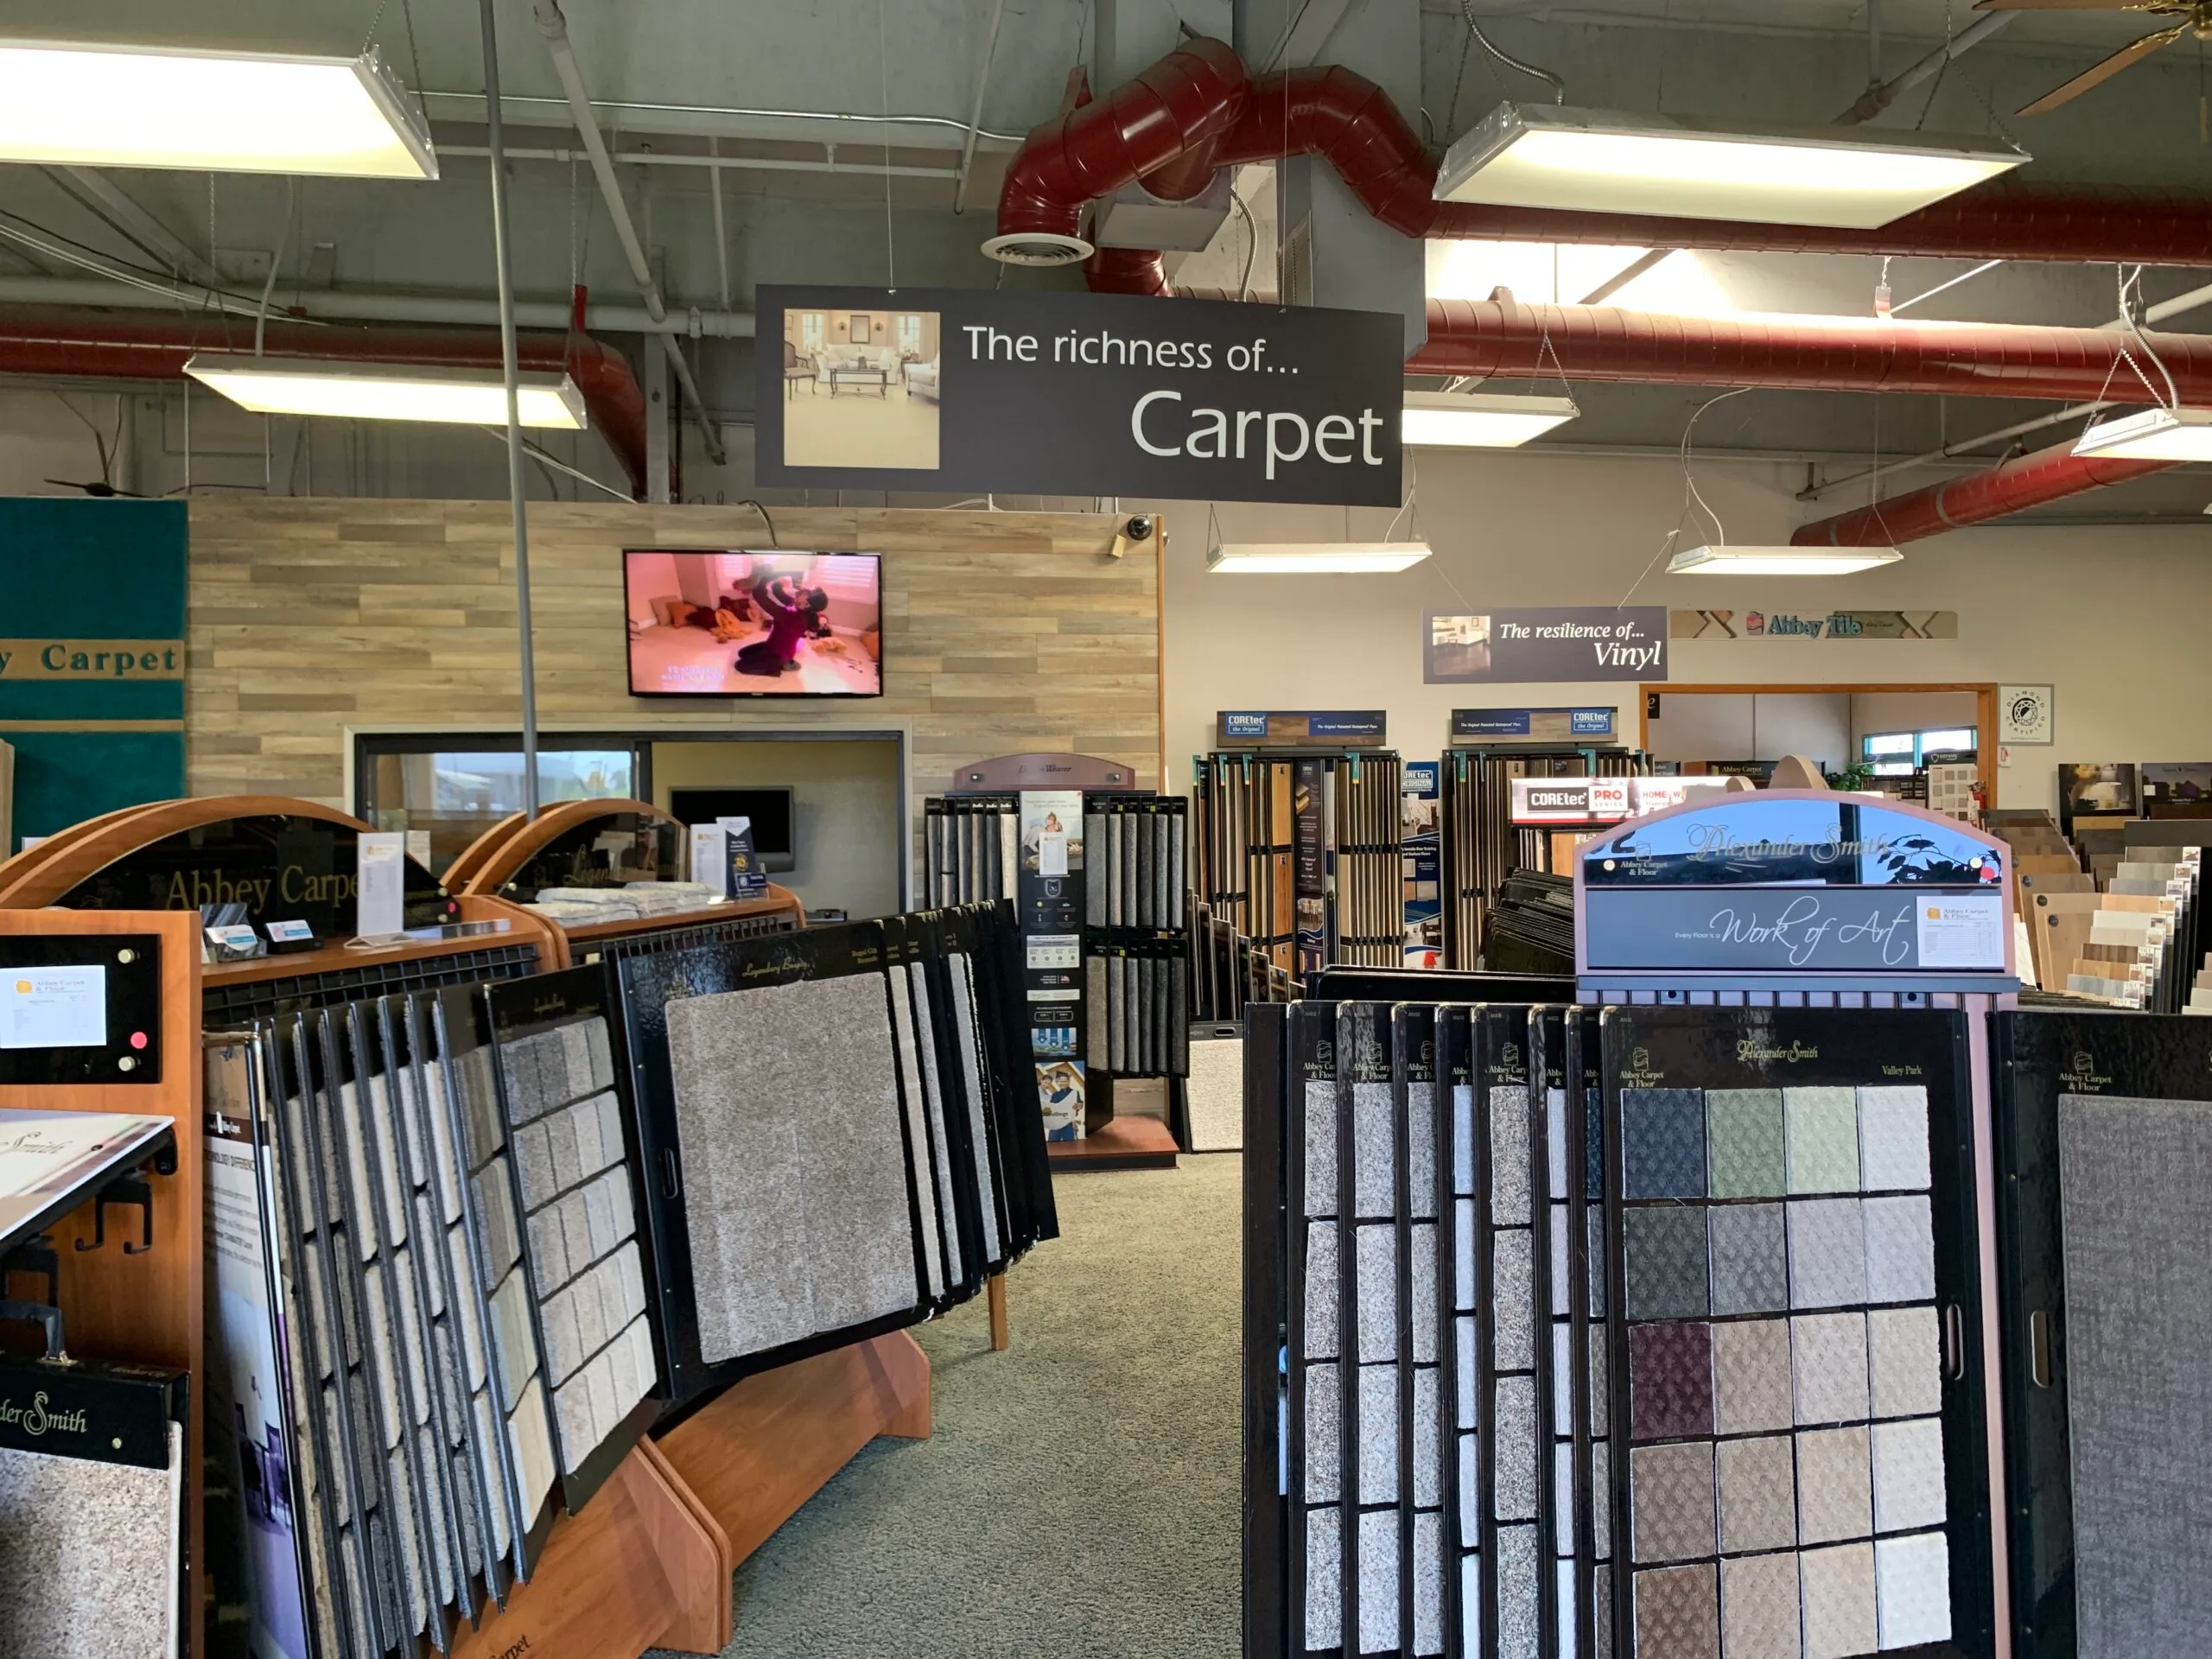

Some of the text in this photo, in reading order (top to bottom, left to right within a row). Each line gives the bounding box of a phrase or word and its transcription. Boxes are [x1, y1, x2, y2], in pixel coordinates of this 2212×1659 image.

[963, 324, 1300, 375] The richness of...
[1130, 389, 1384, 480] Carpet
[1499, 621, 1645, 641] The resilience of...
[1767, 614, 1864, 639] Abbey Tile
[41, 644, 176, 677] Carpet
[1593, 640, 1662, 671] Vinyl
[1228, 715, 1265, 725] COREtec
[1573, 712, 1609, 721] COREtec
[1722, 766, 1741, 774] Abbey
[1530, 790, 1623, 806] COREtec PRO
[1810, 823, 1887, 864] Smith
[166, 865, 358, 914] Abbey Carpe
[1709, 895, 1820, 950] Work
[1789, 917, 1837, 966] of
[1838, 905, 1910, 965] Art
[1737, 1039, 1819, 1063] Alexander Smith
[1303, 1062, 1323, 1071] Abbey
[1353, 1063, 1393, 1072] Abbey Carp
[1407, 1063, 1429, 1071] Abbey
[1489, 1065, 1510, 1075] Abbey
[1882, 1065, 1923, 1077] Valley Park
[1619, 1071, 1664, 1080] Abbey Carpet
[2058, 1072, 2112, 1084] Abbey Carpet
[2077, 1083, 2101, 1091] Floor
[23, 1390, 87, 1436] Smith
